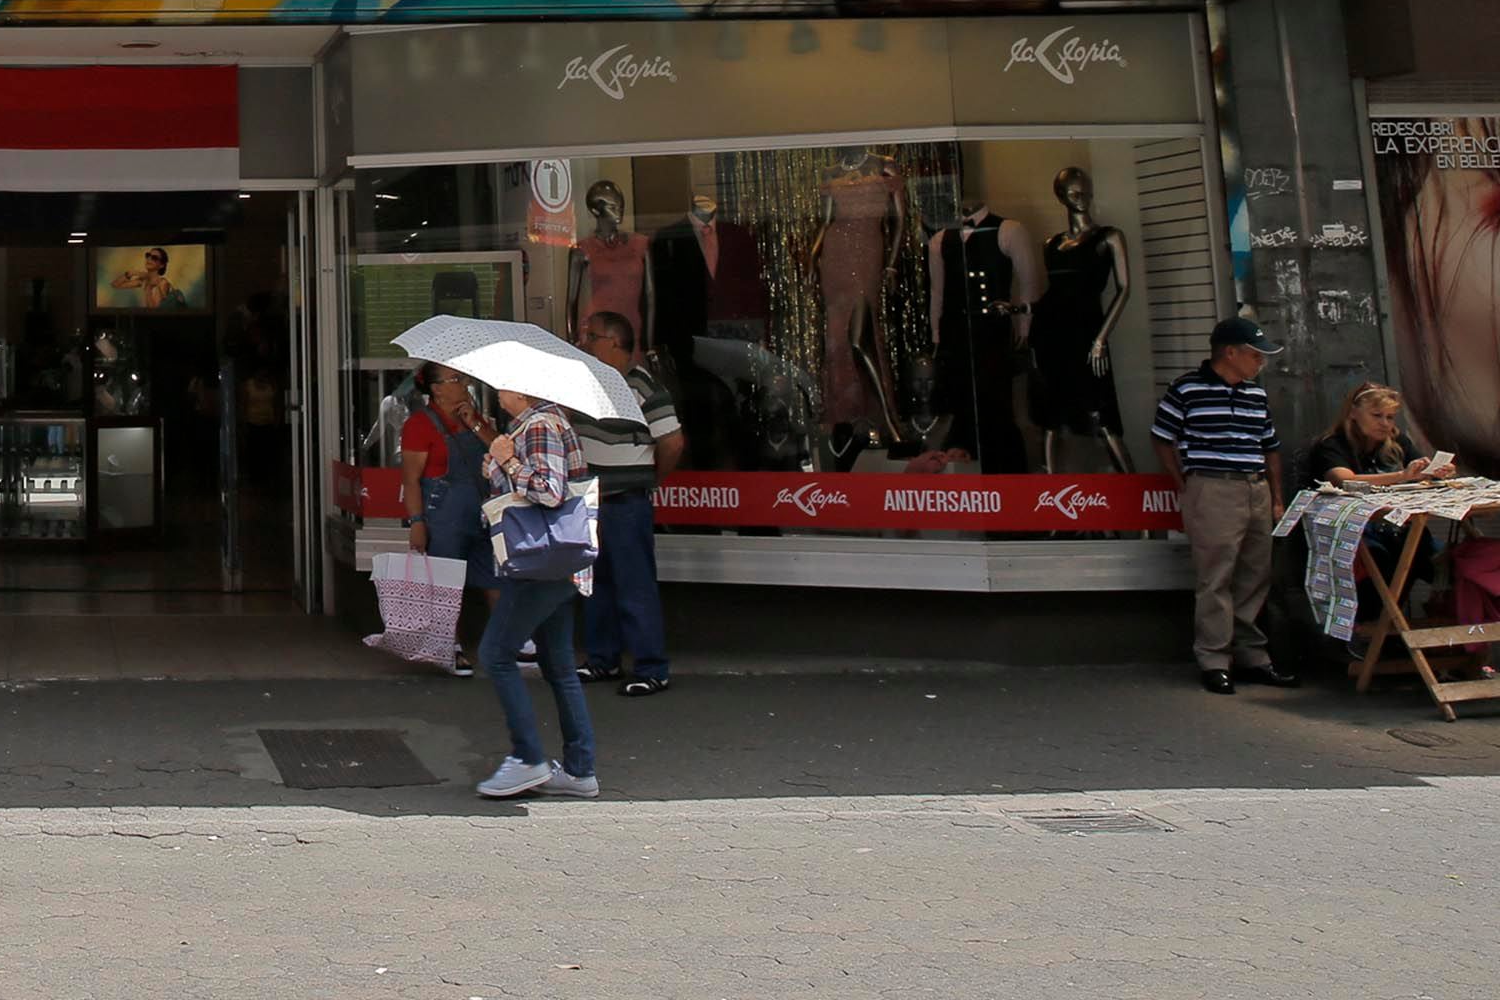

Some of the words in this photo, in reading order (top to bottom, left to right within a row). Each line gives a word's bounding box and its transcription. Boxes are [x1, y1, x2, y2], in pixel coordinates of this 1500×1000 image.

[1373, 137, 1400, 155] LA
[1436, 155, 1456, 169] EN
[884, 489, 1001, 513] ANIVERSARIO
